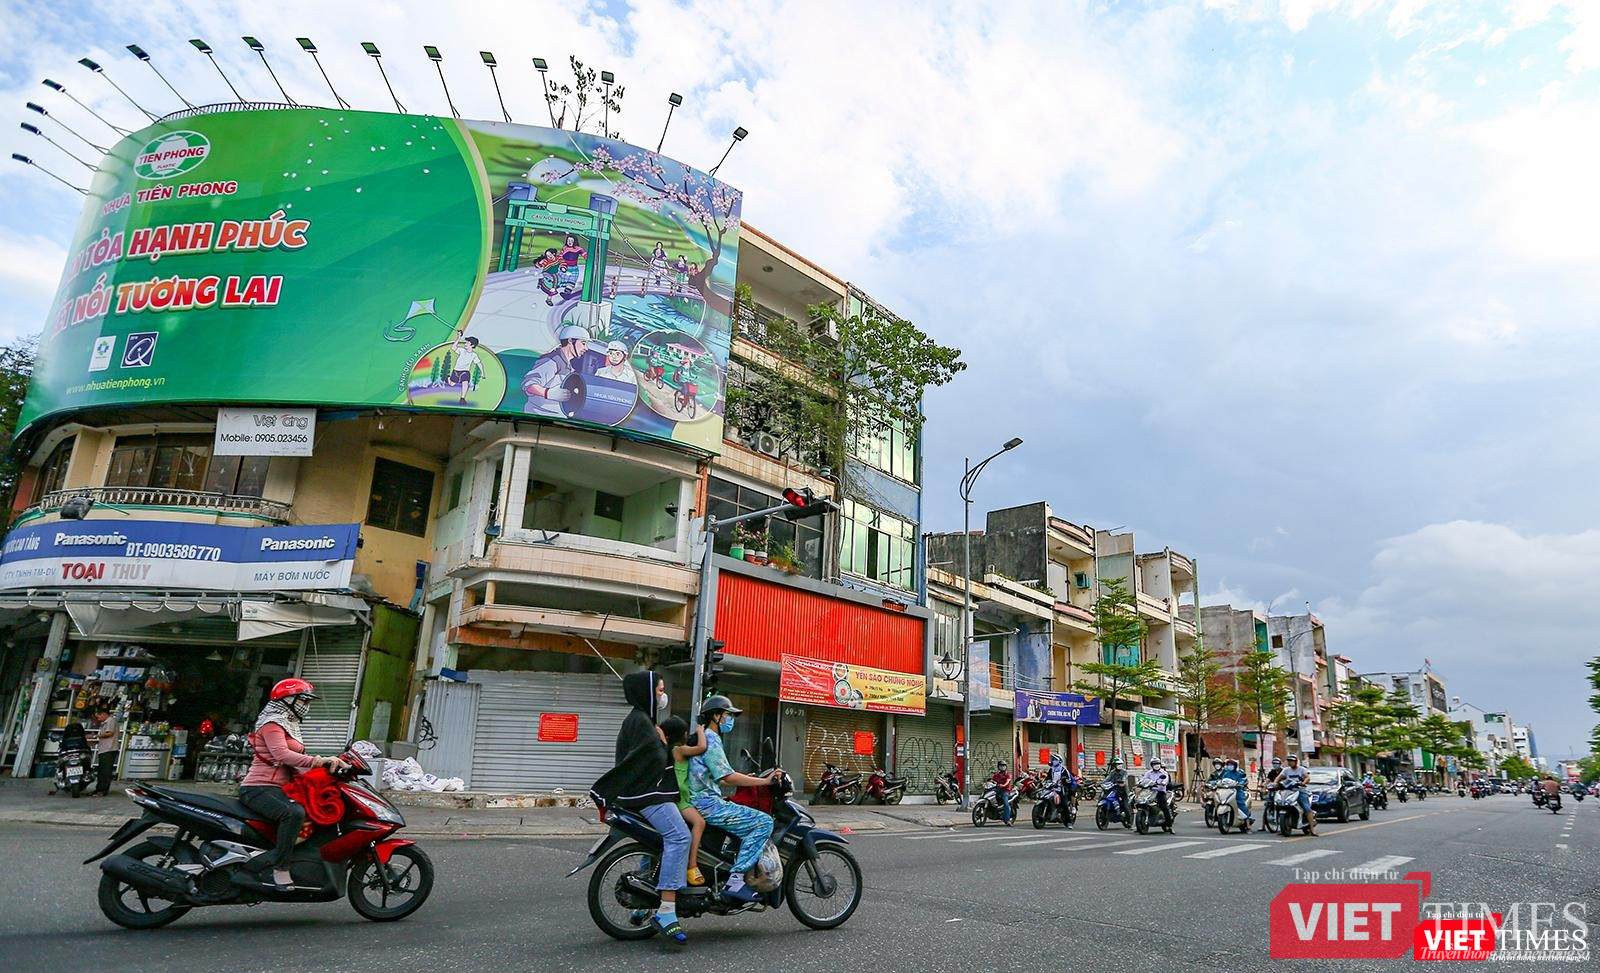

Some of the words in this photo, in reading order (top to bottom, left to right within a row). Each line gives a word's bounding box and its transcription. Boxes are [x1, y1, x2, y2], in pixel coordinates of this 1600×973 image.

[163, 147, 204, 160] PHONG
[138, 185, 173, 202] TIỀN
[178, 180, 237, 197] PHONG
[85, 228, 124, 270] TỎA
[127, 223, 215, 262] HẠNH
[216, 210, 310, 249] PHÚC
[72, 272, 114, 325] NỐI
[116, 275, 221, 313] TƯƠNG
[222, 276, 283, 306] LAI
[66, 377, 166, 394] www.nhuatienphong.vn
[221, 434, 252, 442] Mobile:
[255, 434, 308, 442] 0905.023456
[54, 531, 127, 546] Panasonic
[261, 536, 336, 551] Panasonic
[126, 542, 221, 561] ĐT-0903586770
[62, 563, 105, 582] TOẠI
[302, 569, 330, 580] NƯỚC
